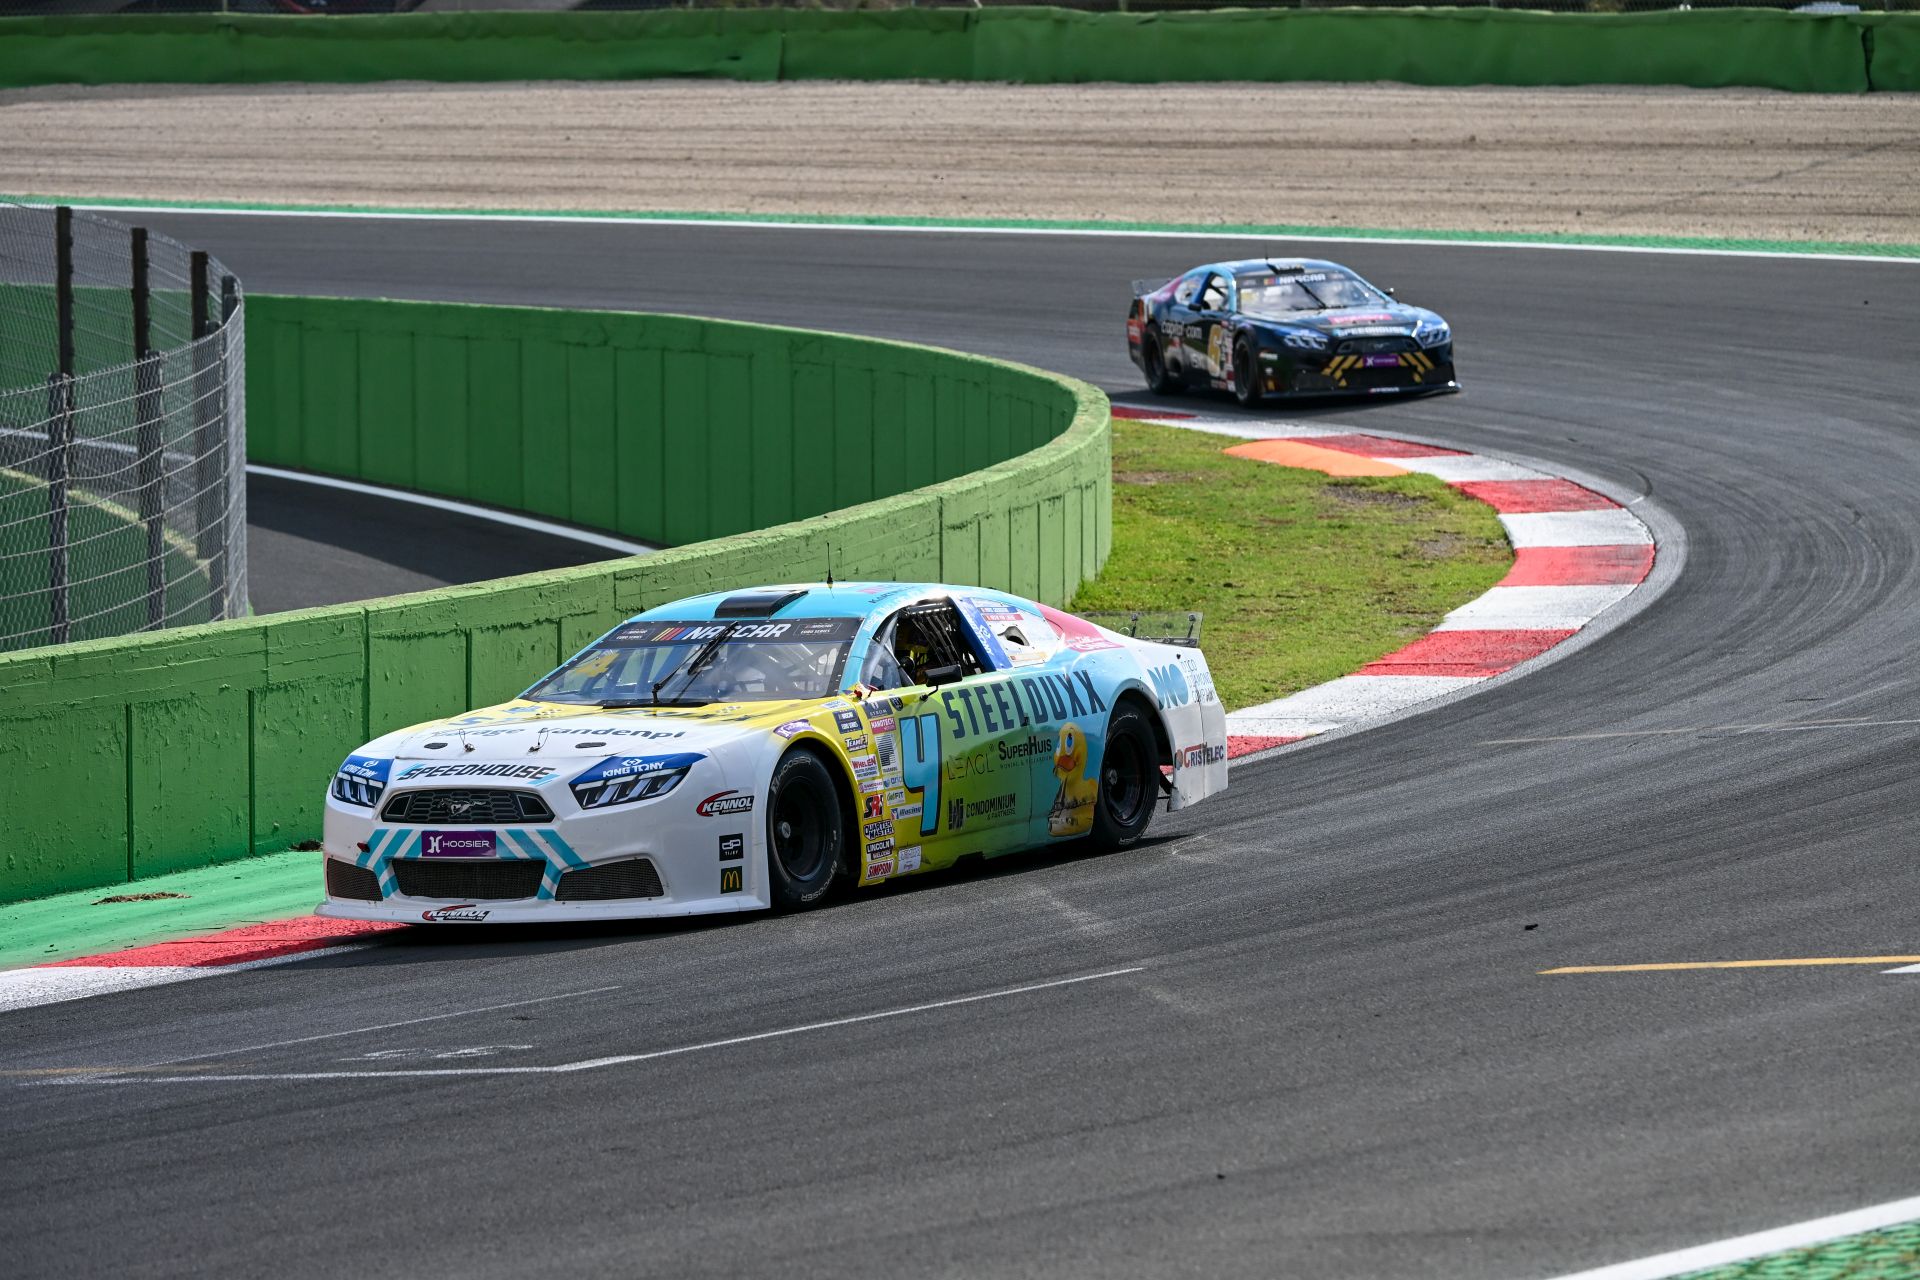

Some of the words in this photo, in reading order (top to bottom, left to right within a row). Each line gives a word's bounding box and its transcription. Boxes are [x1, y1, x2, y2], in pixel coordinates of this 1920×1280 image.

[1280, 273, 1326, 284] NASCAR
[682, 623, 792, 640] NASCAR
[941, 670, 1107, 740] STEELDUXX
[397, 763, 557, 781] SPEEDHOUSE
[602, 767, 631, 778] KING
[632, 761, 665, 774] TONY
[899, 712, 940, 837] 4
[701, 797, 752, 813] KENNOL
[966, 793, 1016, 819] CONDOMINIUM
[865, 820, 891, 836] QUARTER
[870, 826, 893, 839] MASTER
[443, 840, 490, 848] HOOSIER
[867, 839, 890, 852] LINCOLN
[868, 860, 893, 878] SIMPSON
